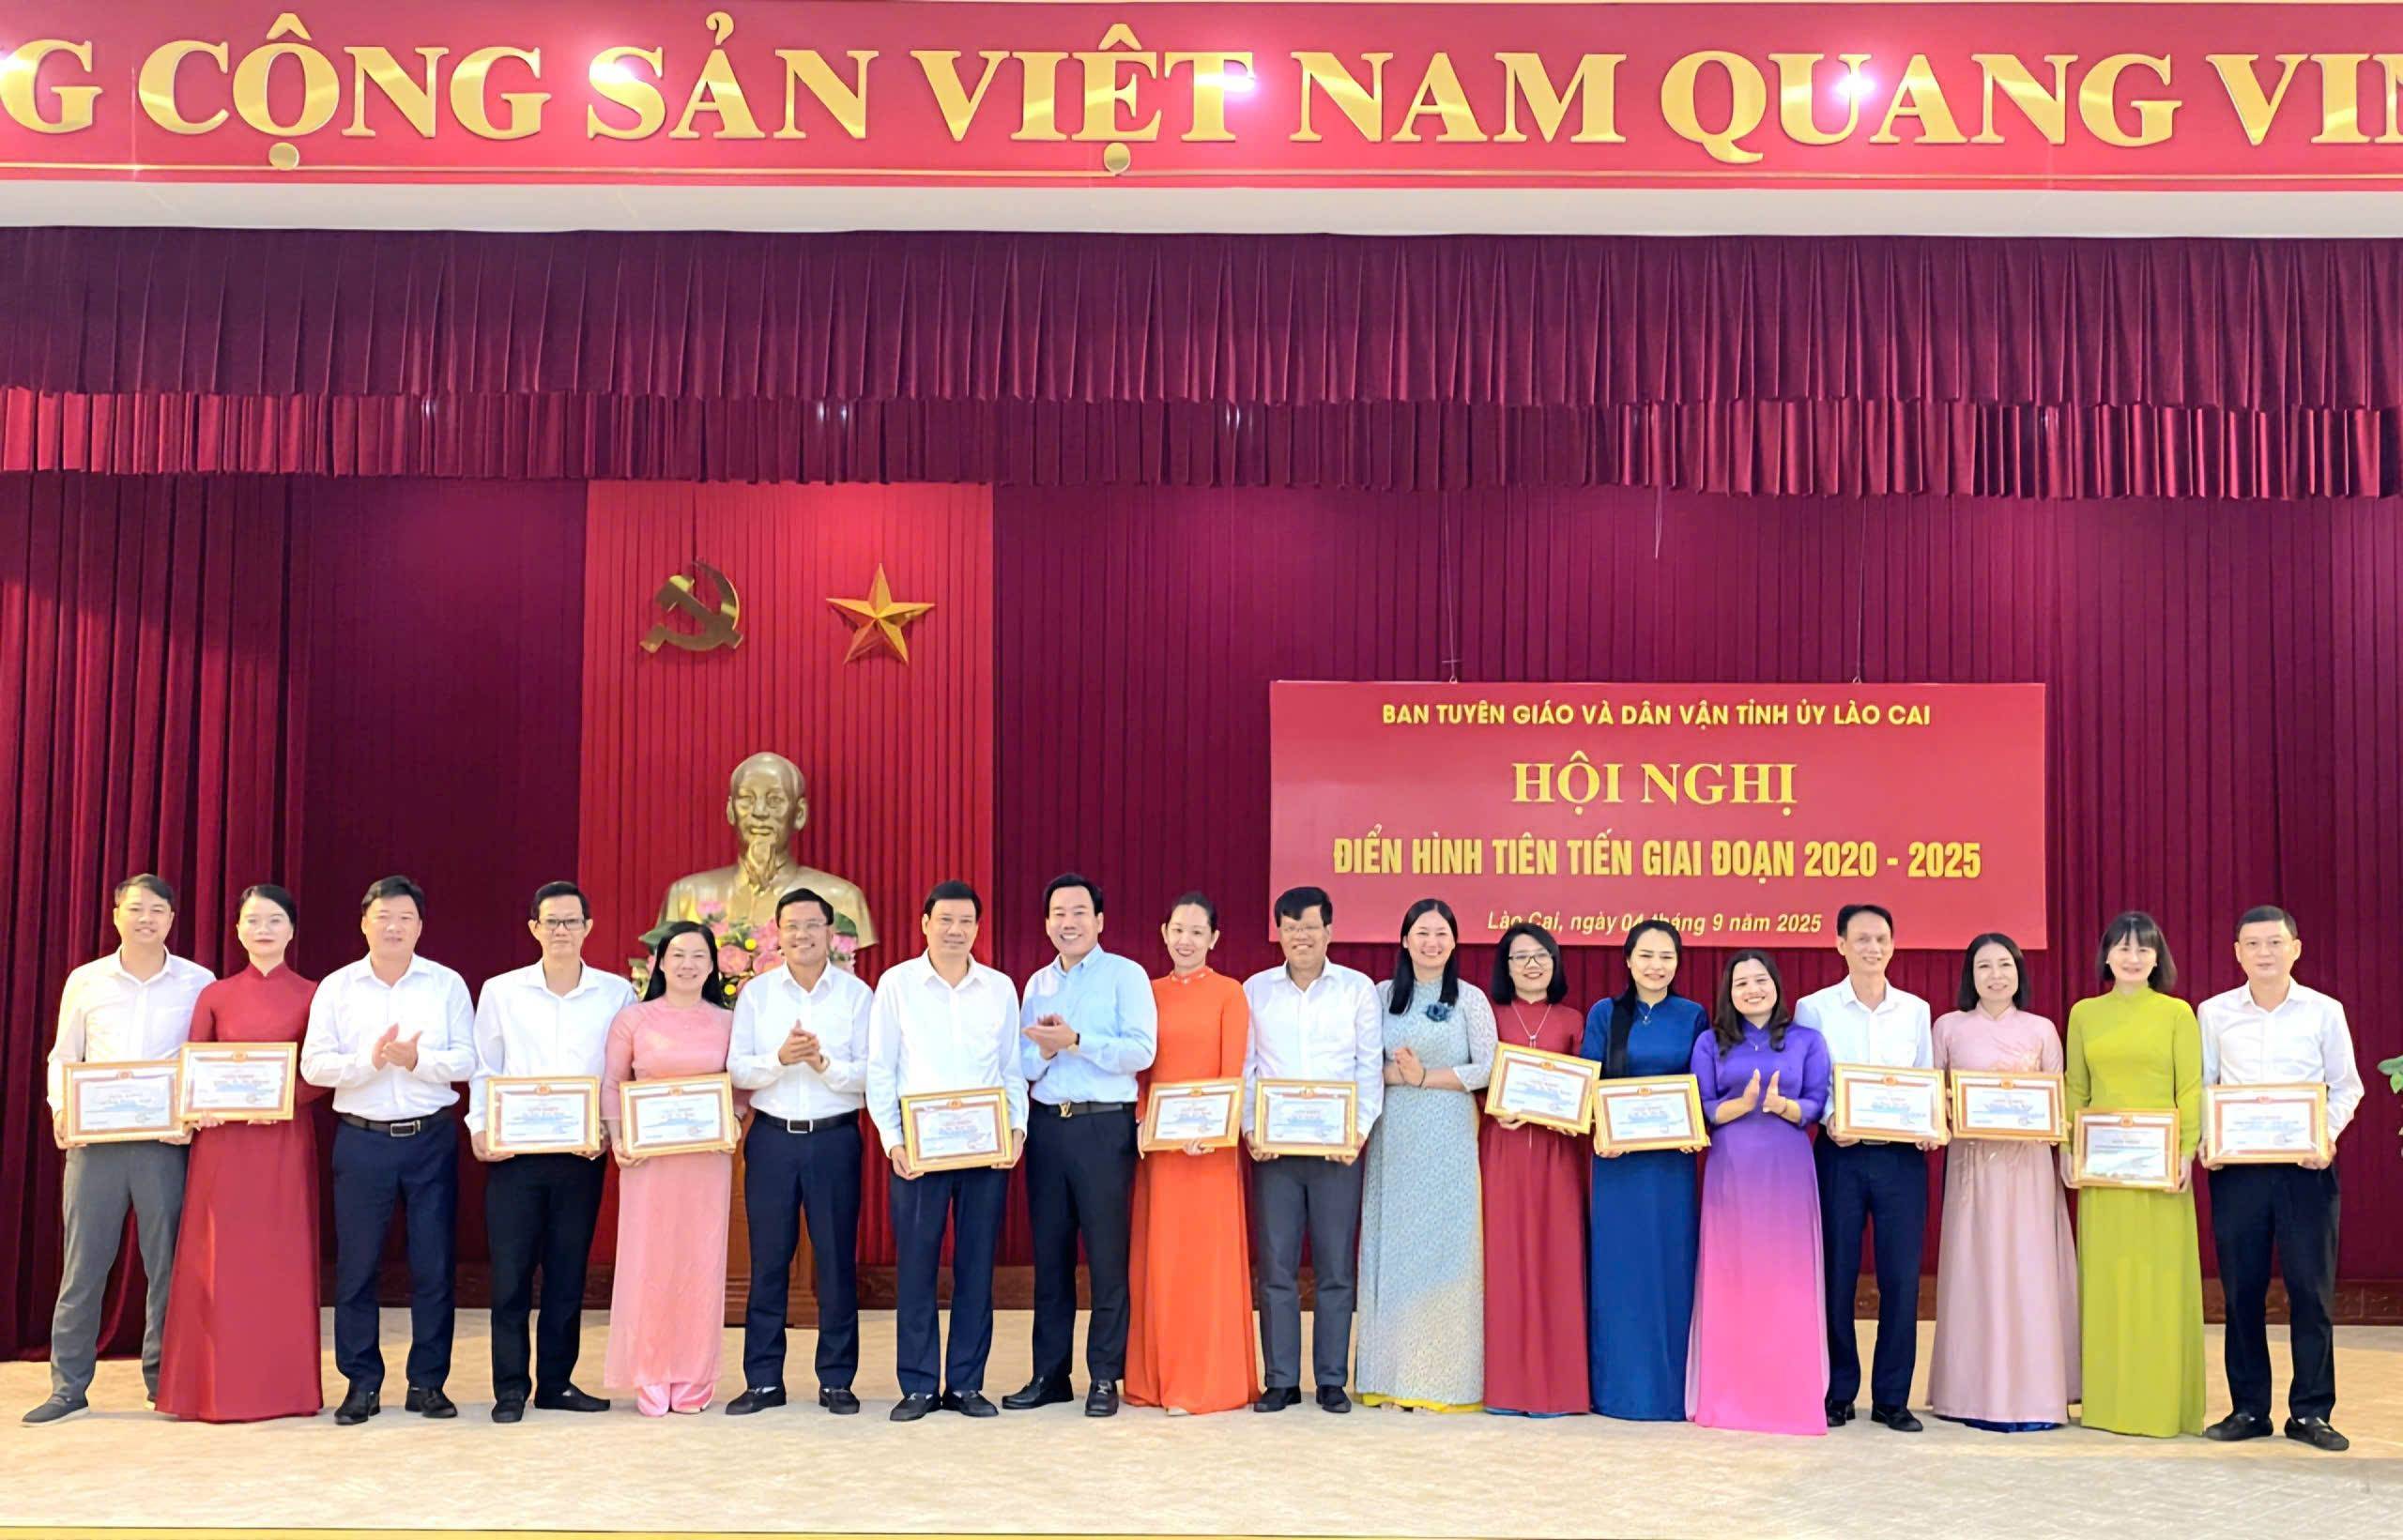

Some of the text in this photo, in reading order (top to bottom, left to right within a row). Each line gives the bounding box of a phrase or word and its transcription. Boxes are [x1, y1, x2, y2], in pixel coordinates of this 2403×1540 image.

[138, 12, 552, 172] CỘNG
[584, 11, 880, 140] SẢN
[911, 23, 1255, 176] VIỆT
[1289, 51, 1627, 144] NAM
[1661, 50, 2182, 164] QUANG
[1383, 698, 1931, 730] BAN TUYÊN GIÁO VÀ DÂN VẬN TỈNH ỦY LÀO CAI
[1511, 750, 1798, 816] HỘI NGHỊ
[1332, 823, 1982, 885] ĐIỂN HÌNH TIÊN TIẾN GIAI ĐOẠN 2020 - 2025
[1487, 910, 1523, 930] Lào
[1527, 910, 1563, 933] Cai,
[1570, 911, 1617, 935] ngày
[1712, 913, 1723, 932] 9
[1729, 912, 1770, 932] năm
[1776, 913, 1822, 933] 2025
